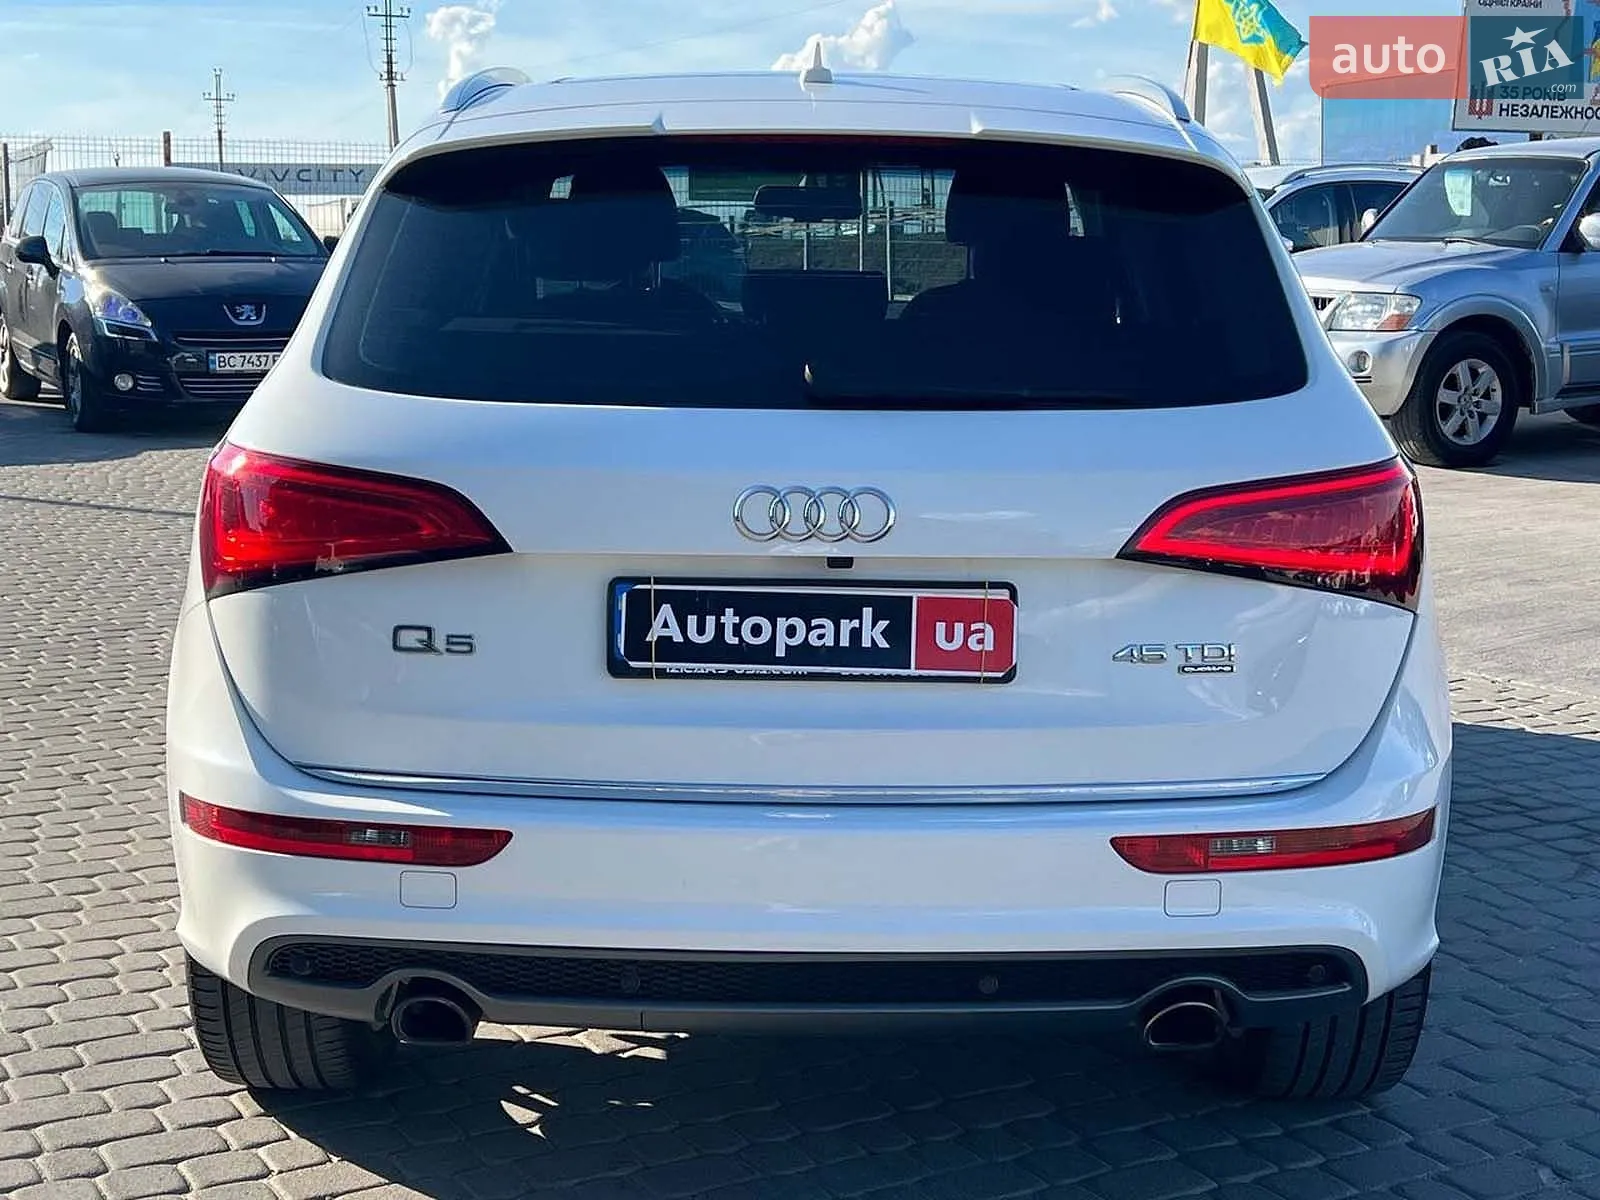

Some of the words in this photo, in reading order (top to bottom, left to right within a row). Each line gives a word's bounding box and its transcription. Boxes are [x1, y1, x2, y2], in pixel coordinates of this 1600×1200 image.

[1500, 85, 1519, 99] 35
[1522, 87, 1567, 102] РОКІВ
[217, 355, 236, 369] BC
[239, 354, 270, 368] 7437
[392, 624, 476, 655] Q5
[645, 603, 891, 657] Autopark
[935, 621, 995, 651] ua
[1112, 643, 1167, 664] 45
[1175, 643, 1236, 664] TDI
[1183, 665, 1233, 674] quattro
